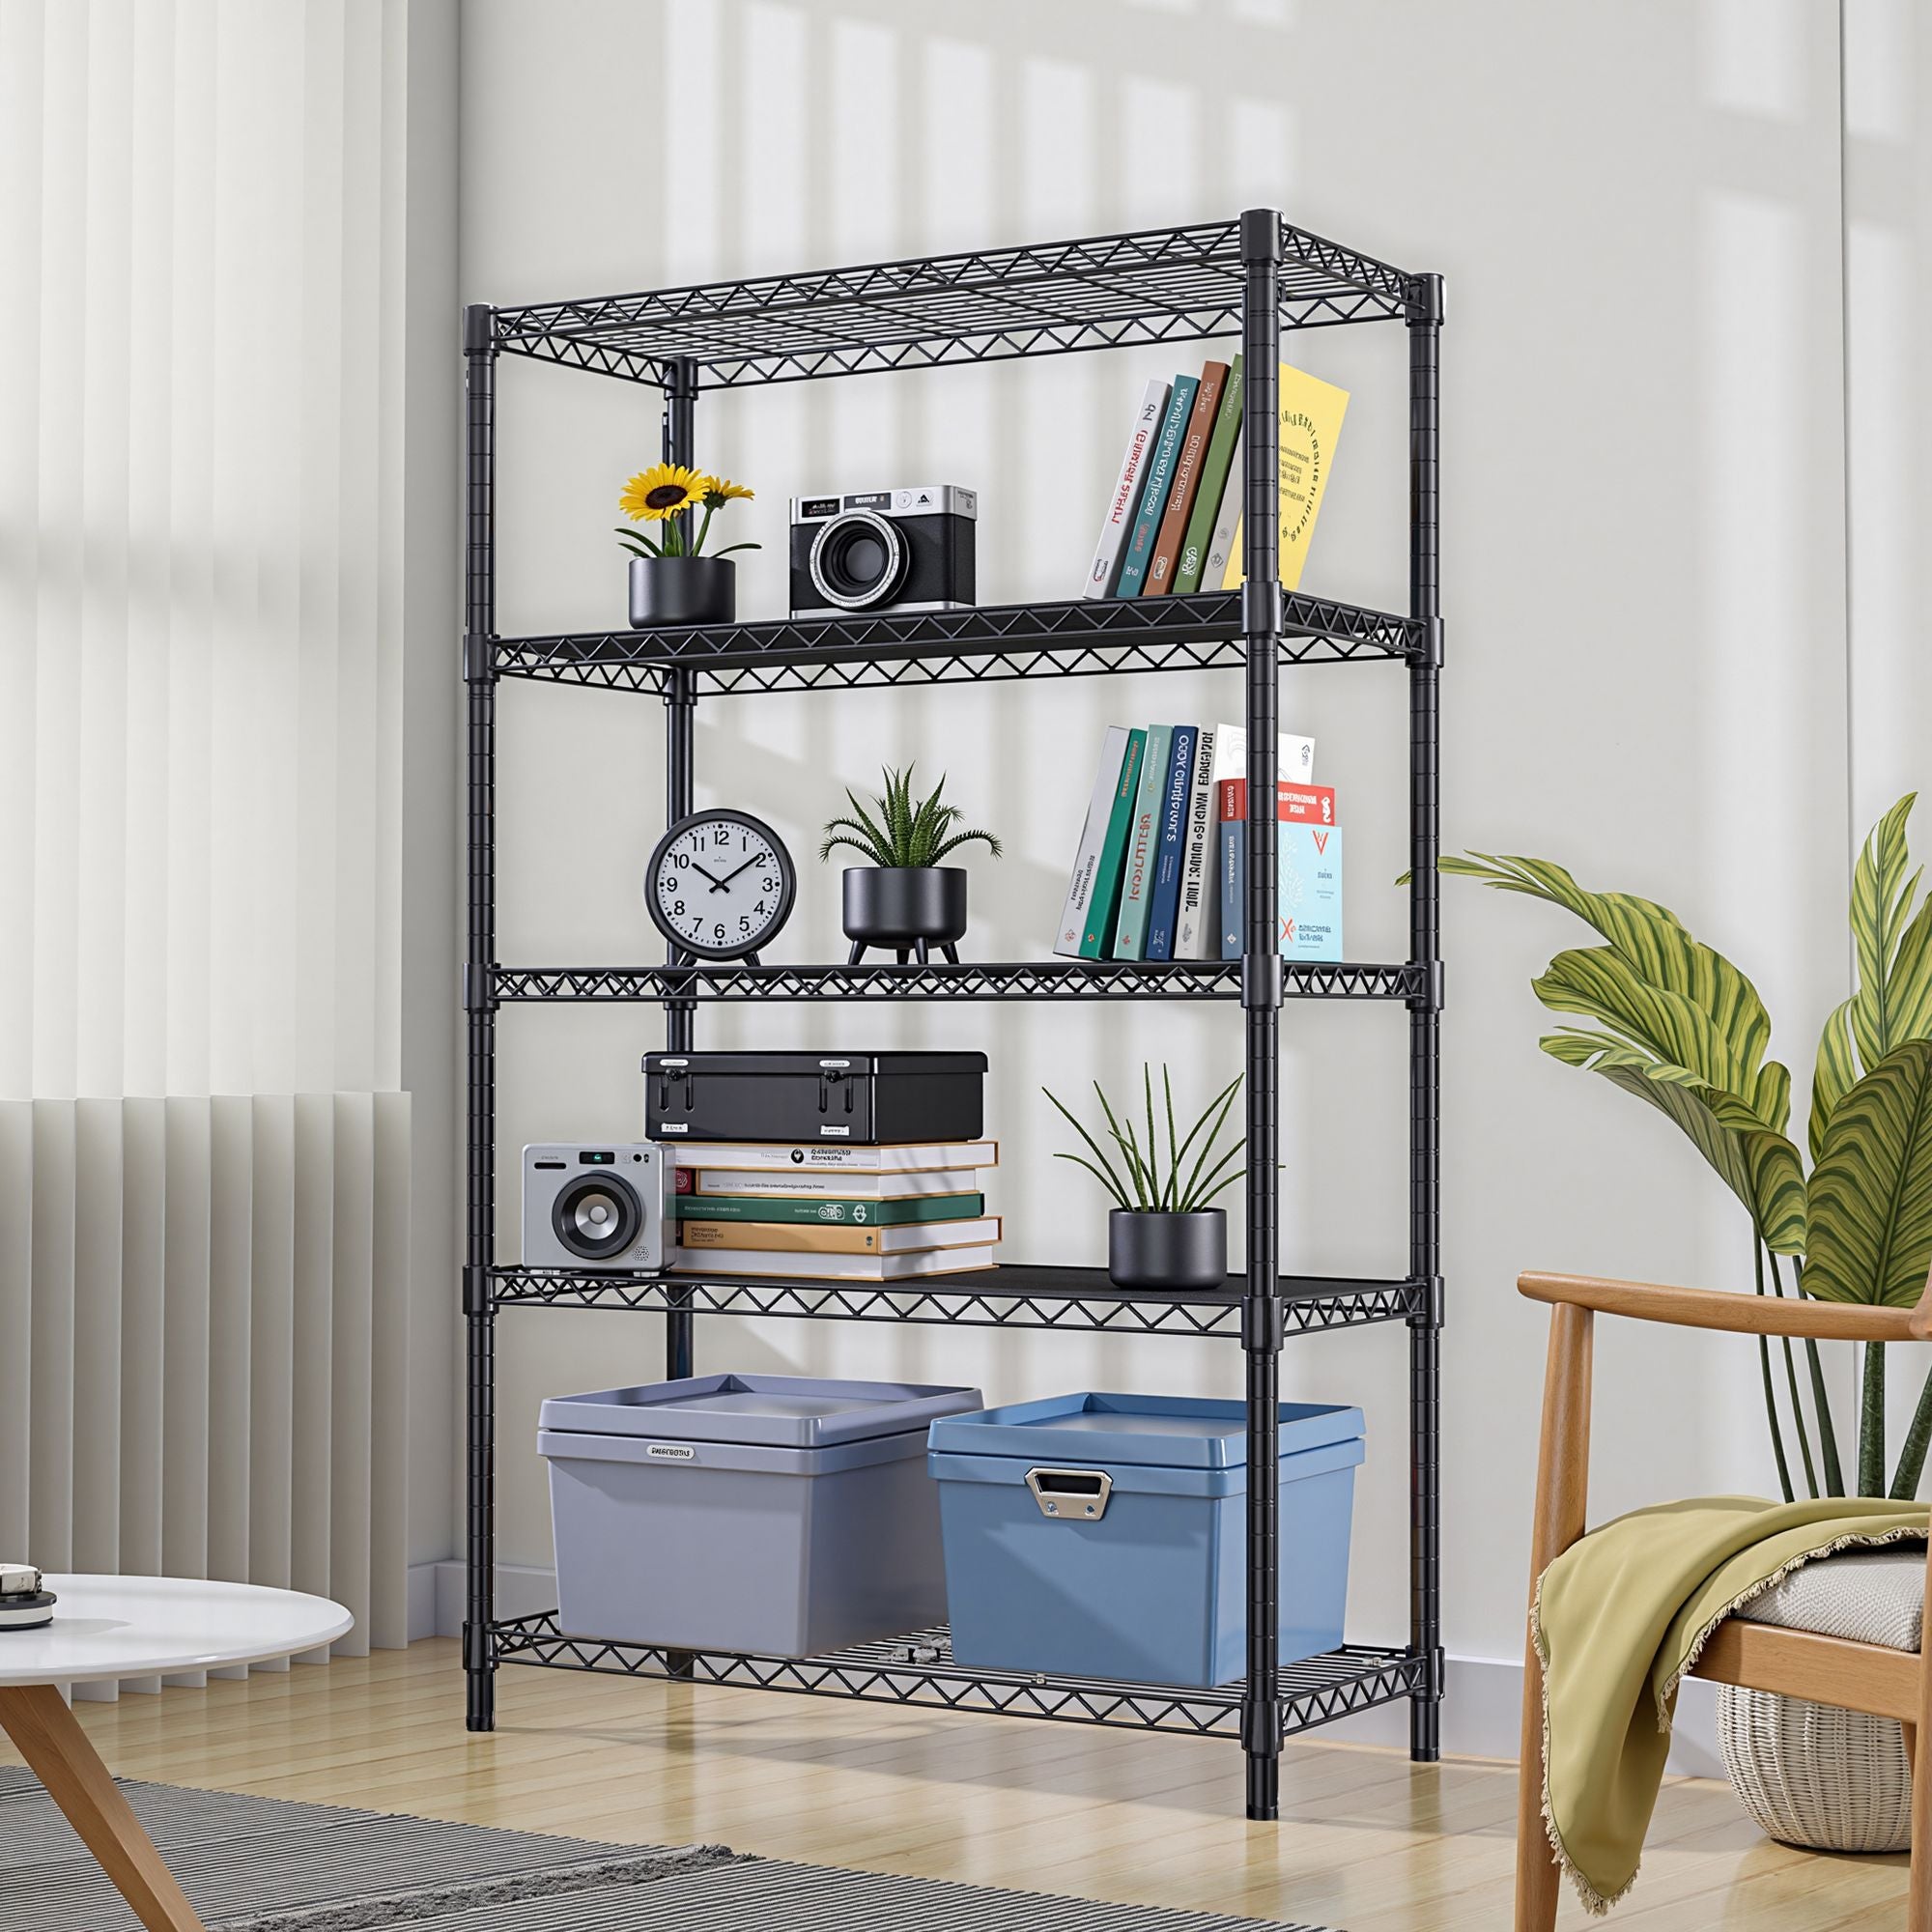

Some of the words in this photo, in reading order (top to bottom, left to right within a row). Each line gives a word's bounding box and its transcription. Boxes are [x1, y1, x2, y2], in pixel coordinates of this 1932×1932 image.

[692, 836, 705, 852] 11
[714, 830, 730, 846] 12
[672, 853, 690, 869] 10
[754, 852, 767, 867] 2
[666, 876, 678, 893] 9
[761, 876, 774, 893] 3
[673, 899, 686, 917] 8
[753, 899, 766, 916] 4
[692, 917, 704, 933] 7
[713, 923, 725, 940] 6
[738, 915, 751, 932] 5
